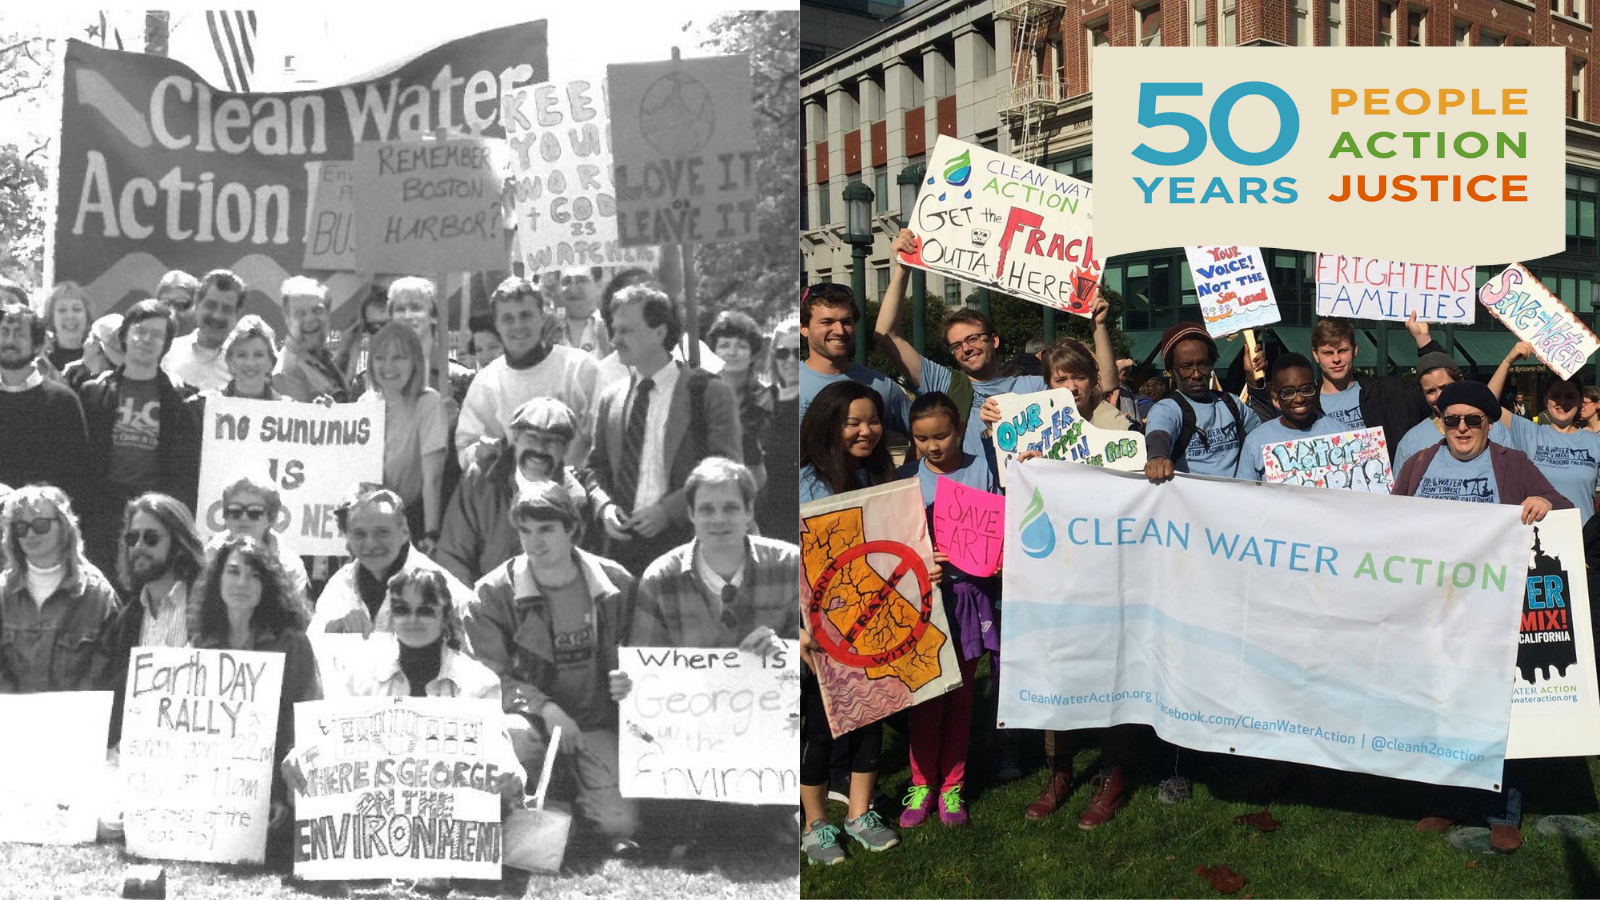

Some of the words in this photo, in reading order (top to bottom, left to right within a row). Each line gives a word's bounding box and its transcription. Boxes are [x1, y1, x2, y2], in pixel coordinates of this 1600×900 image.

[150, 73, 328, 155] Clean
[341, 63, 534, 143] Water
[503, 78, 611, 133] KEE
[378, 144, 491, 176] REMEMBER
[510, 123, 613, 172] YOU
[402, 177, 483, 202] BOSTON
[515, 163, 616, 203] WOR
[615, 156, 705, 201] LOVE
[717, 152, 757, 190] IT
[987, 159, 1049, 187] CLEAN
[1055, 178, 1093, 199] WAT
[72, 149, 290, 244] Action
[549, 192, 618, 224] GOD
[918, 193, 973, 233] GET
[980, 207, 1003, 223] the
[982, 177, 1079, 214] ACTION
[312, 210, 355, 256] BU
[384, 202, 501, 244] HARBOR?
[570, 221, 597, 237] IS
[618, 207, 703, 246] LEAVE
[716, 199, 757, 238] IT
[921, 238, 990, 275] OUTTA
[1195, 255, 1255, 279] VOICE!
[1206, 246, 1242, 262] YOUR
[1317, 253, 1475, 292] FRIGHTENS
[1197, 281, 1231, 298] NOT
[1236, 272, 1265, 287] THE
[1317, 282, 1466, 319] FAMILIES
[215, 411, 251, 441] no
[260, 415, 371, 446] sununus
[997, 402, 1044, 453] OUR
[1070, 435, 1090, 461] IN
[1105, 438, 1138, 463] PITS
[1272, 438, 1364, 472] Water
[1438, 478, 1463, 487] WATER
[301, 503, 346, 539] NE
[948, 486, 1000, 535] SAVE
[1068, 517, 1190, 550] CLEAN
[1204, 527, 1339, 576] WATER
[1353, 552, 1507, 592] ACTION
[845, 571, 903, 643] FRACK
[1520, 609, 1568, 632] MIX!
[872, 634, 918, 665] WITH
[1519, 631, 1571, 644] CALIFORNIA
[133, 651, 207, 698] Earth
[219, 652, 267, 703] DAY
[637, 648, 741, 669] Where
[635, 673, 782, 736] George
[1540, 685, 1577, 694] ACTION
[157, 697, 243, 739] RALLY
[1020, 688, 1152, 706] CleanWaterAction.org
[1371, 735, 1485, 762] @cleanh2oaction
[374, 757, 397, 788] IS
[396, 757, 501, 795] GEORGE
[401, 789, 455, 819] THE
